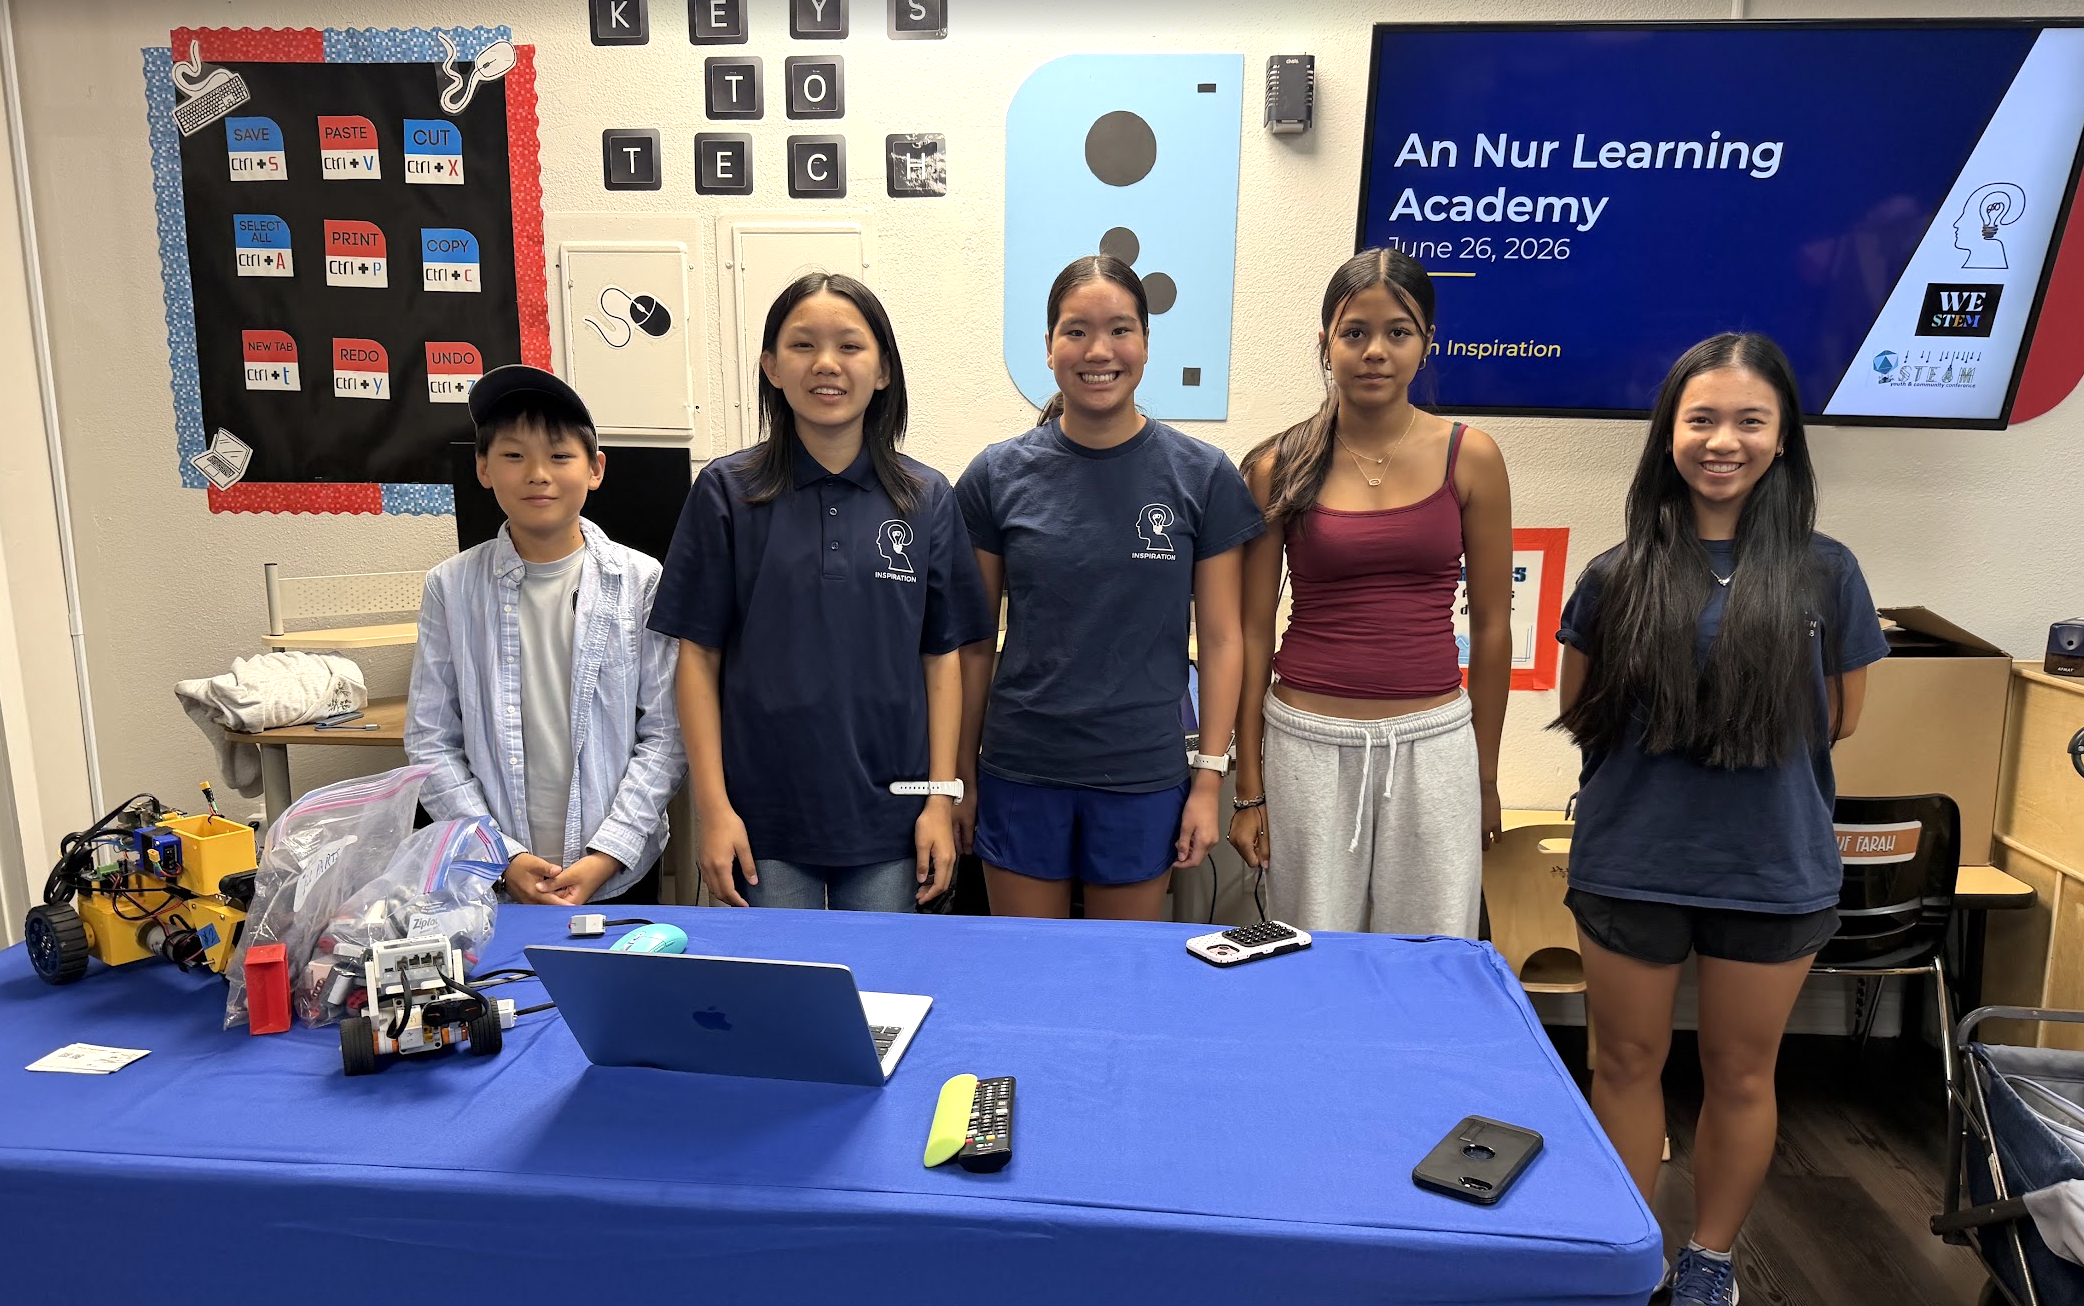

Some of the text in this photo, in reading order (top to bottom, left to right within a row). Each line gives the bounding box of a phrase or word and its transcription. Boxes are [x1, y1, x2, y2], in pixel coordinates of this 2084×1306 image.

[724, 74, 827, 103] TO
[233, 127, 270, 141] SAVE
[325, 126, 368, 139] PASTE
[413, 129, 451, 146] CUT
[1394, 130, 1784, 179] An Nur Learning
[622, 147, 927, 181] TECH
[1389, 187, 1610, 232] Academy
[239, 220, 282, 231] SELECT
[251, 232, 272, 243] ALL
[332, 231, 380, 247] PRINT
[426, 239, 470, 253] COPY
[1458, 236, 1497, 263] 26,
[1503, 236, 1571, 260] 2026
[1939, 291, 1987, 312] WE
[1931, 314, 1981, 328] STEM
[248, 341, 294, 352] NEW TAB
[1447, 339, 1562, 360] Inspiration
[340, 348, 380, 363] REDO
[431, 351, 475, 365] UNDO
[1898, 365, 1977, 384] STEAM
[1913, 381, 1945, 389] community
[1131, 551, 1176, 561] INSPIRATION
[874, 571, 917, 583] INSPIRATION
[1855, 834, 1897, 852] FARAH
